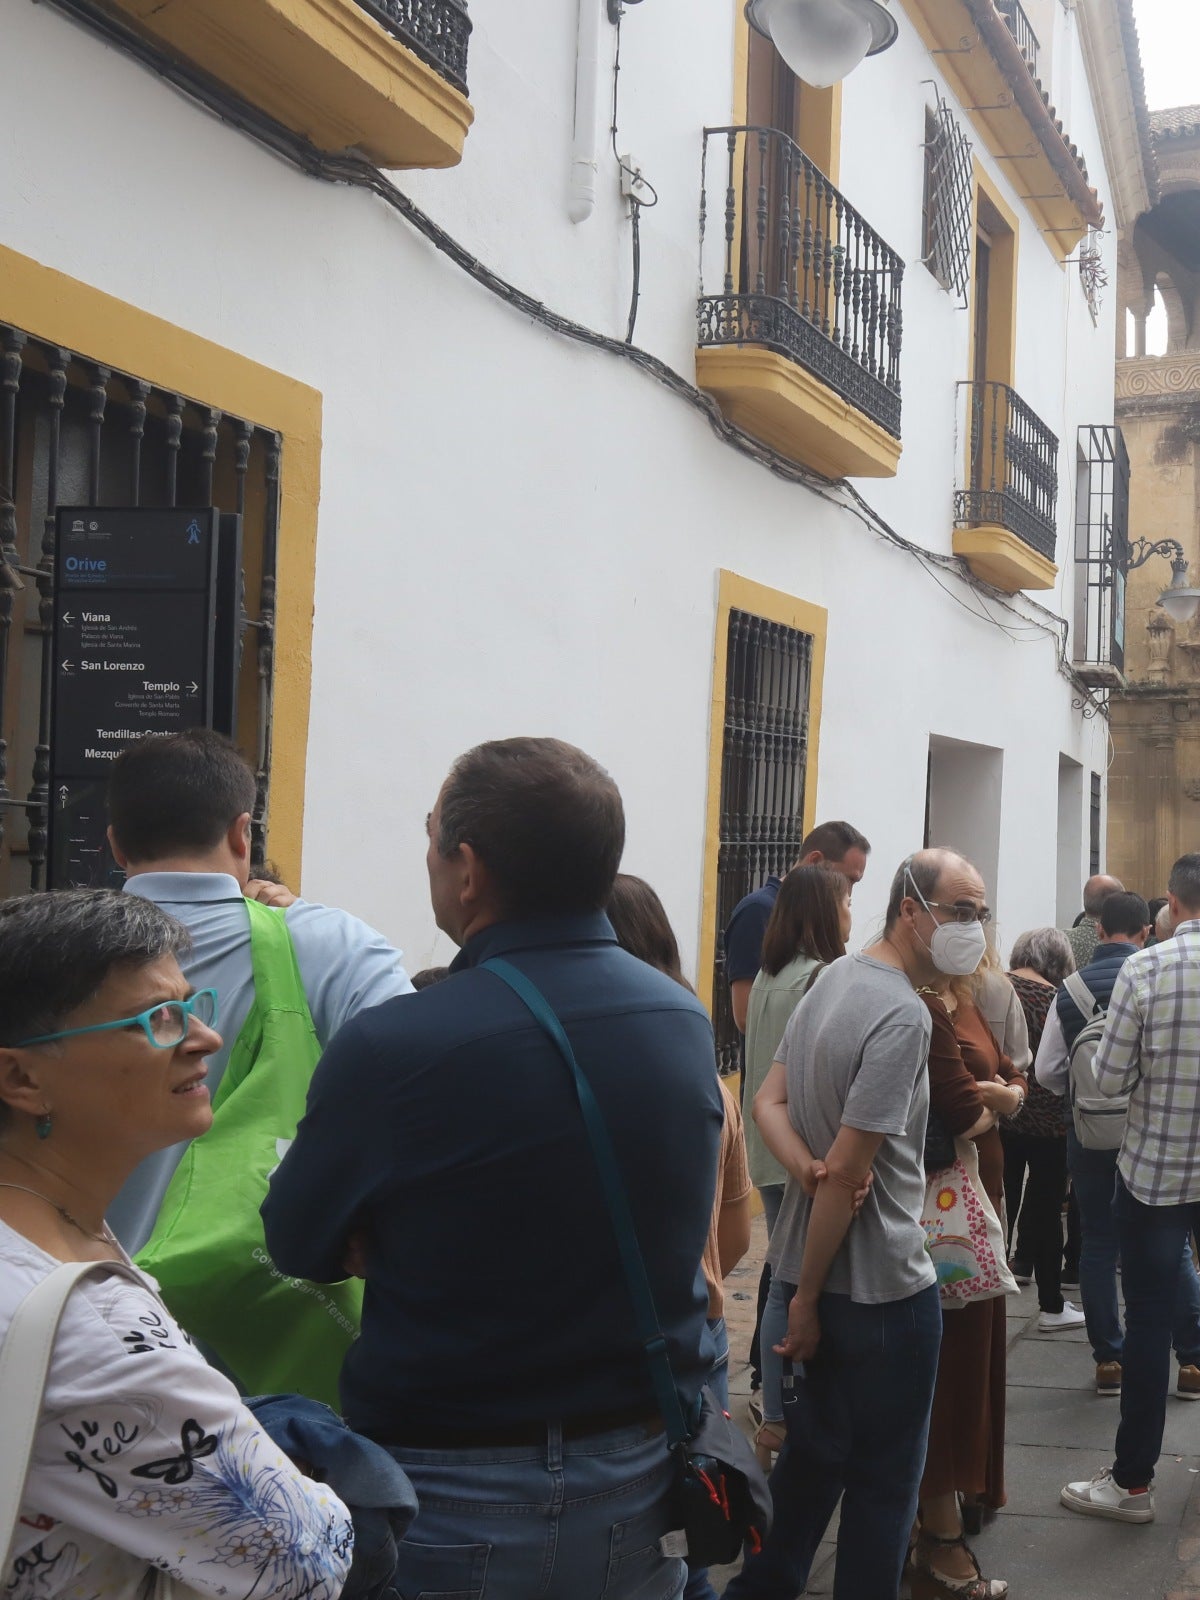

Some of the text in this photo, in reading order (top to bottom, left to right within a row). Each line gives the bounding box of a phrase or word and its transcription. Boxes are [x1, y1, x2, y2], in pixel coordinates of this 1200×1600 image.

[65, 556, 107, 571] Orive
[81, 612, 111, 622] Viana
[80, 661, 145, 671] San Lorenzo
[142, 681, 180, 693] Templo
[290, 1278, 326, 1302] Santa
[325, 1299, 354, 1333] Teresa
